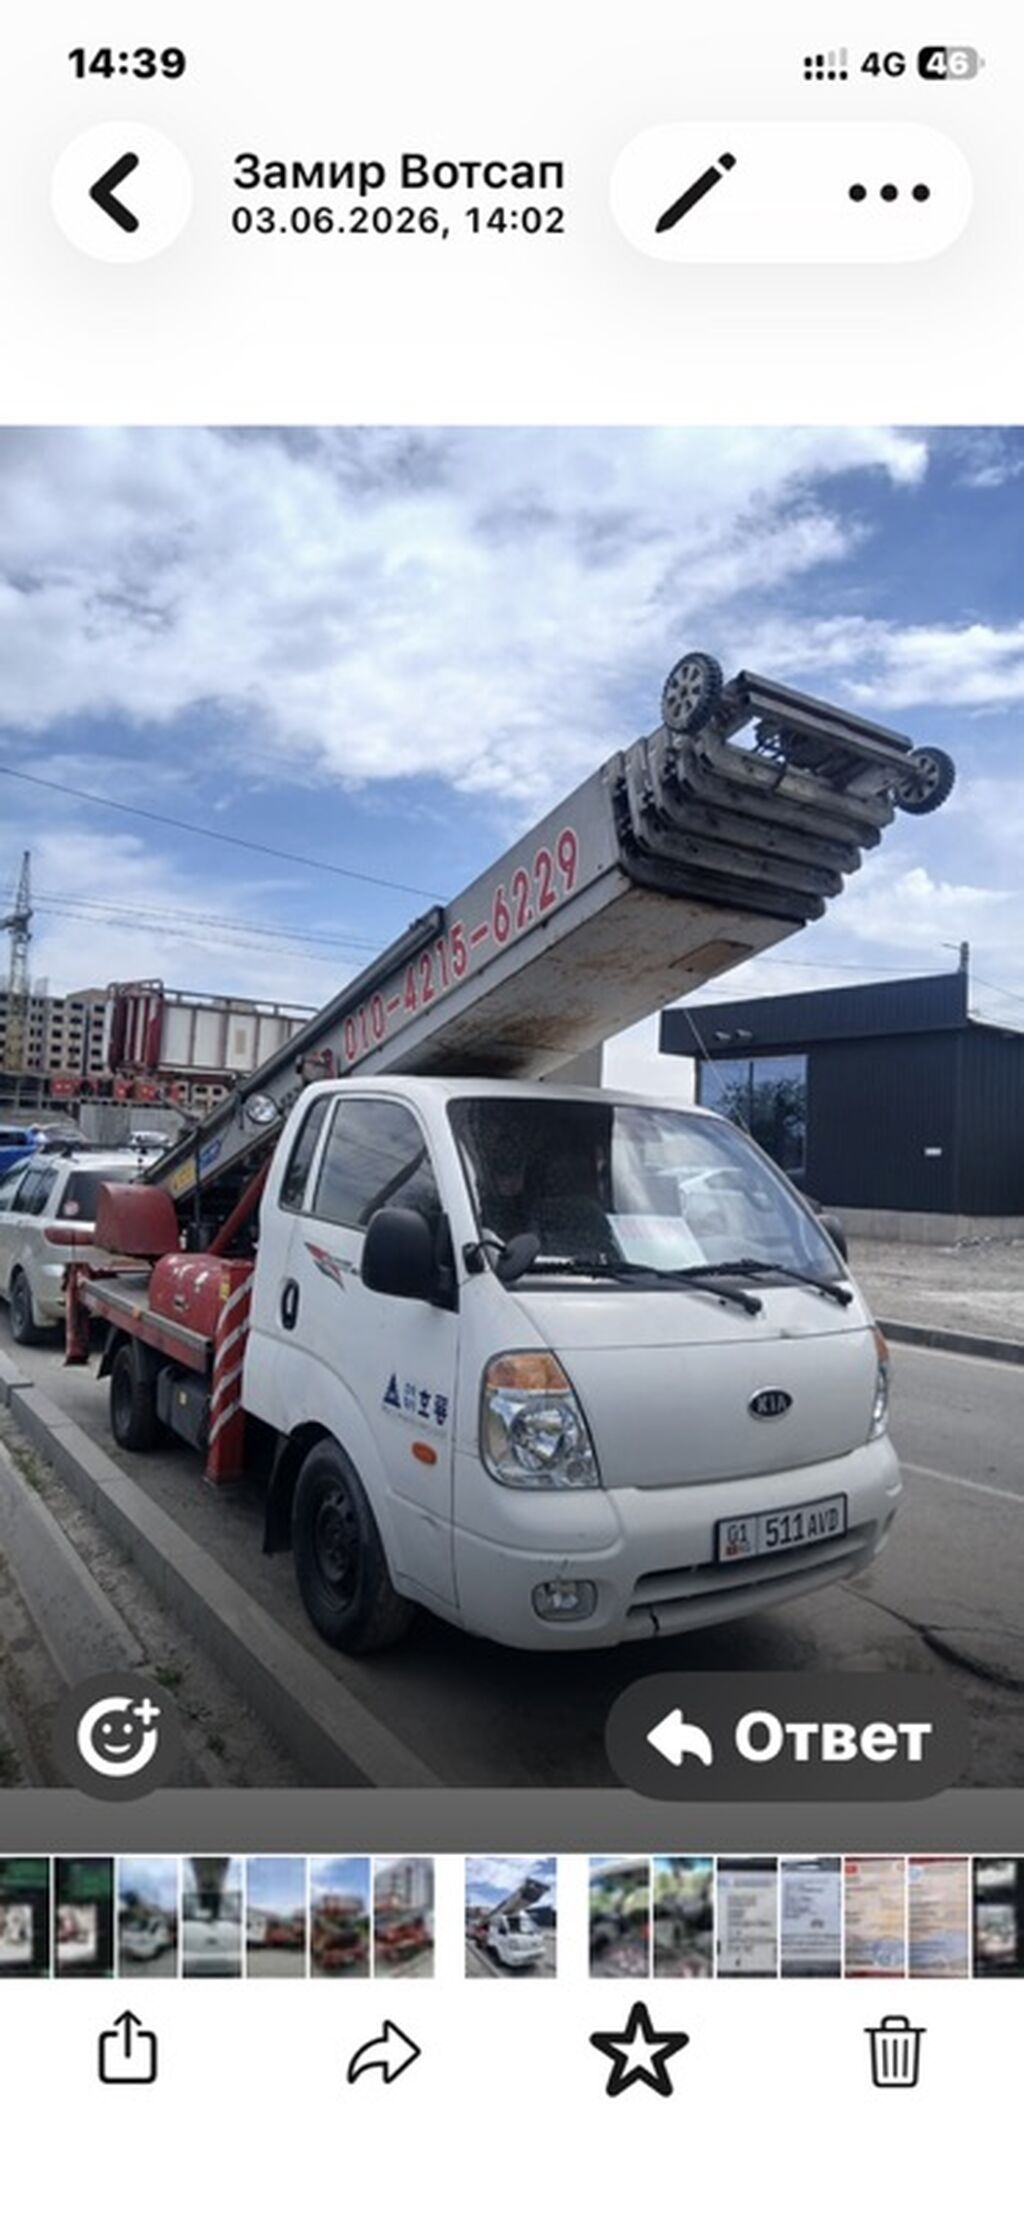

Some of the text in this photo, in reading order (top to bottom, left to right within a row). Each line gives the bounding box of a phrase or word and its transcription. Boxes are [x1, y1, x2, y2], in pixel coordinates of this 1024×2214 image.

[344, 829, 578, 1062] 010-4215-6229
[756, 1394, 788, 1413] KIA
[726, 1524, 748, 1545] 01
[765, 1513, 804, 1548] 511
